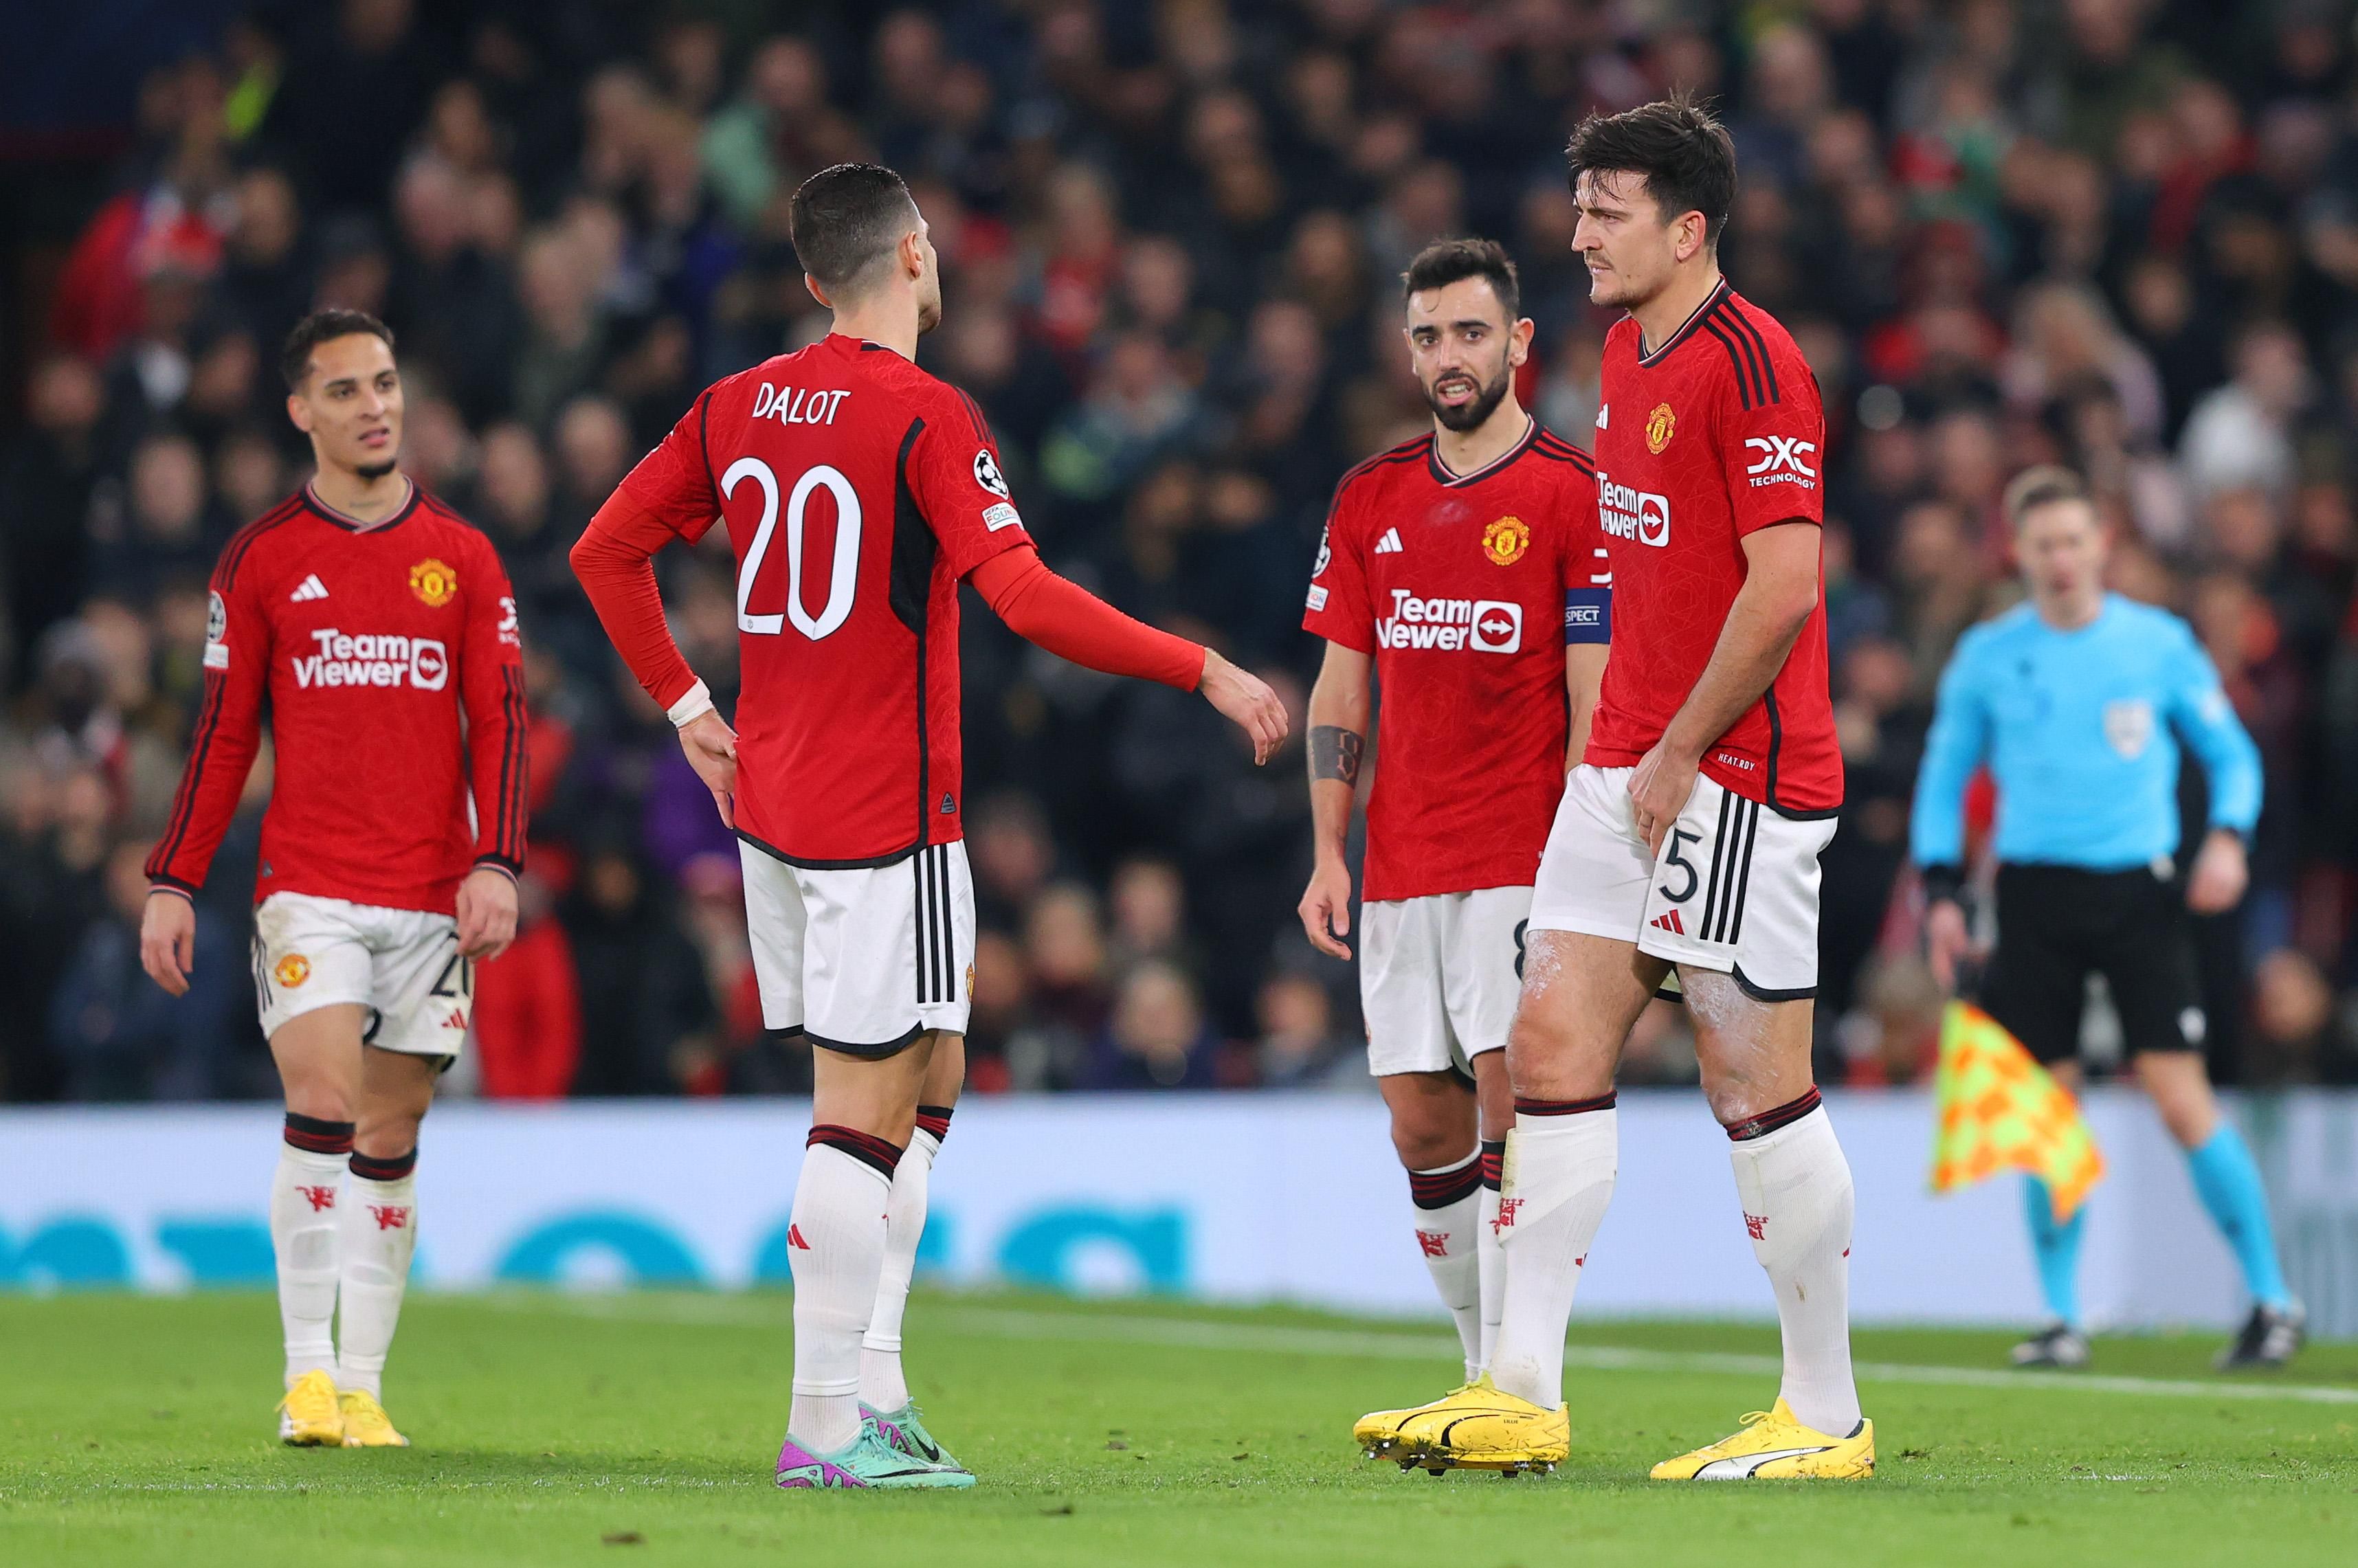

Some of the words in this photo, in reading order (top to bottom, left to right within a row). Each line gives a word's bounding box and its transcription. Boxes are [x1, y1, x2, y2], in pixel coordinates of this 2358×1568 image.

[753, 382, 852, 426] DALOT
[1745, 435, 1815, 478] DXC
[1597, 471, 1638, 514] Team
[1749, 473, 1815, 490] TECHNOLOGY
[1597, 498, 1638, 541] iewer
[720, 456, 863, 641] 20
[1390, 589, 1471, 625] Team
[1566, 609, 1600, 623] SPECT
[311, 627, 410, 661] Team
[1375, 617, 1469, 651] Vewer
[291, 654, 410, 688] Viewer
[1718, 752, 1755, 771] HEAT.RDY
[1658, 827, 1704, 904] 5
